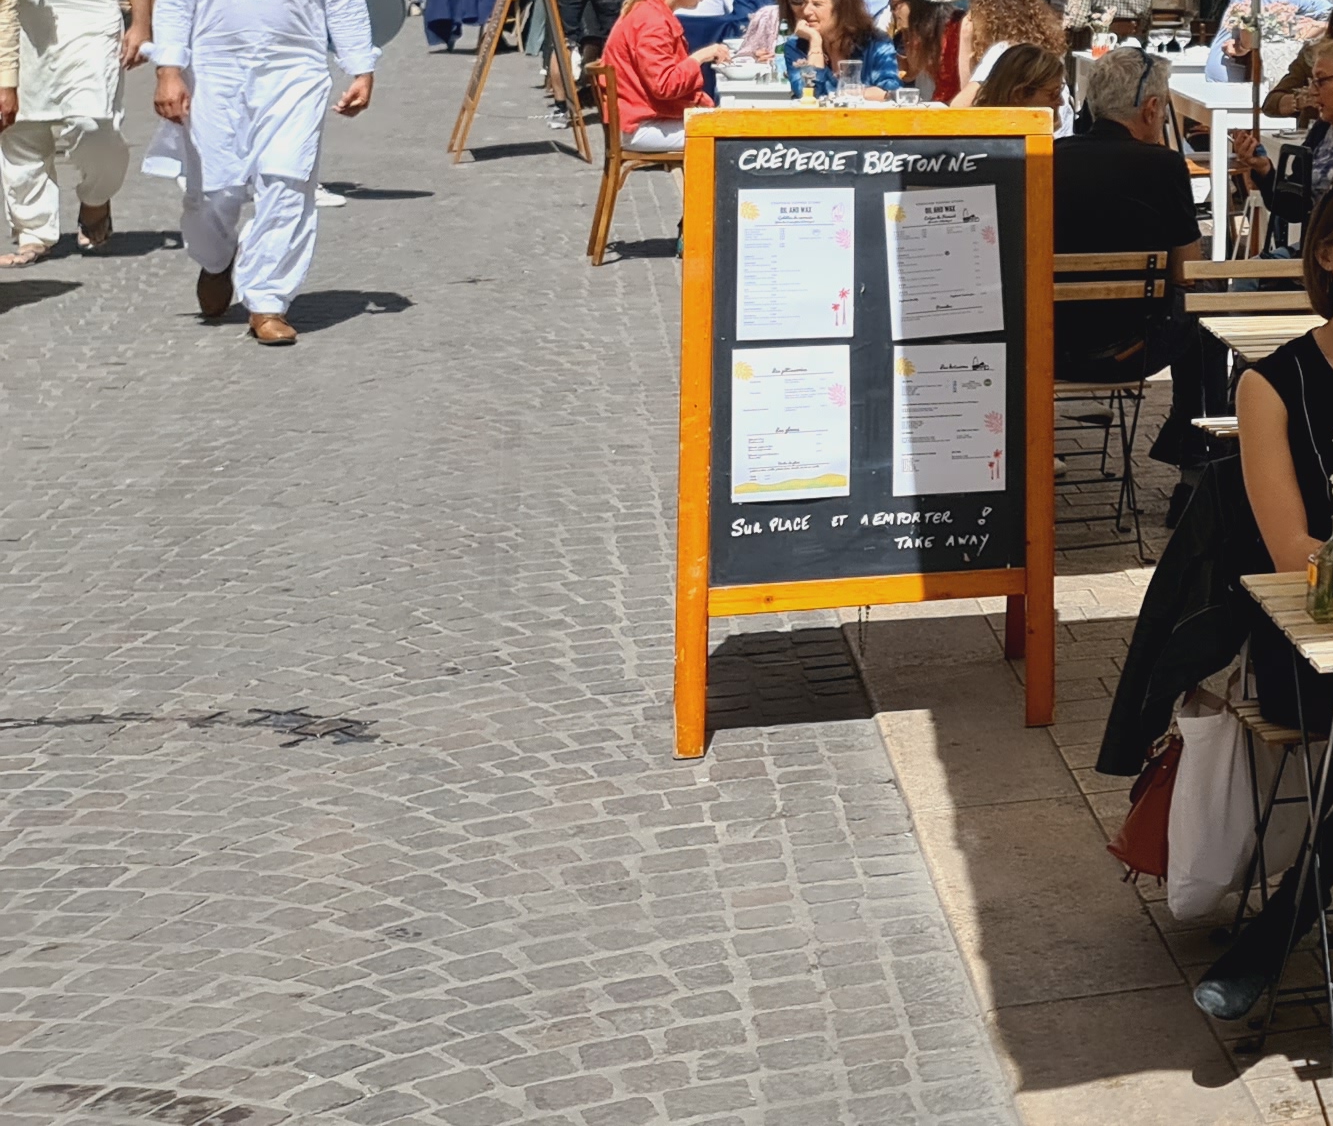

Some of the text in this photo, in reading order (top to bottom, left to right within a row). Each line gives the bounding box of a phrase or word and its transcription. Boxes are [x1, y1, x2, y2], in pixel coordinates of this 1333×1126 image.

[769, 515, 811, 533] PLACE
[831, 515, 849, 527] ET
[893, 533, 991, 558] TAKE AWAY
